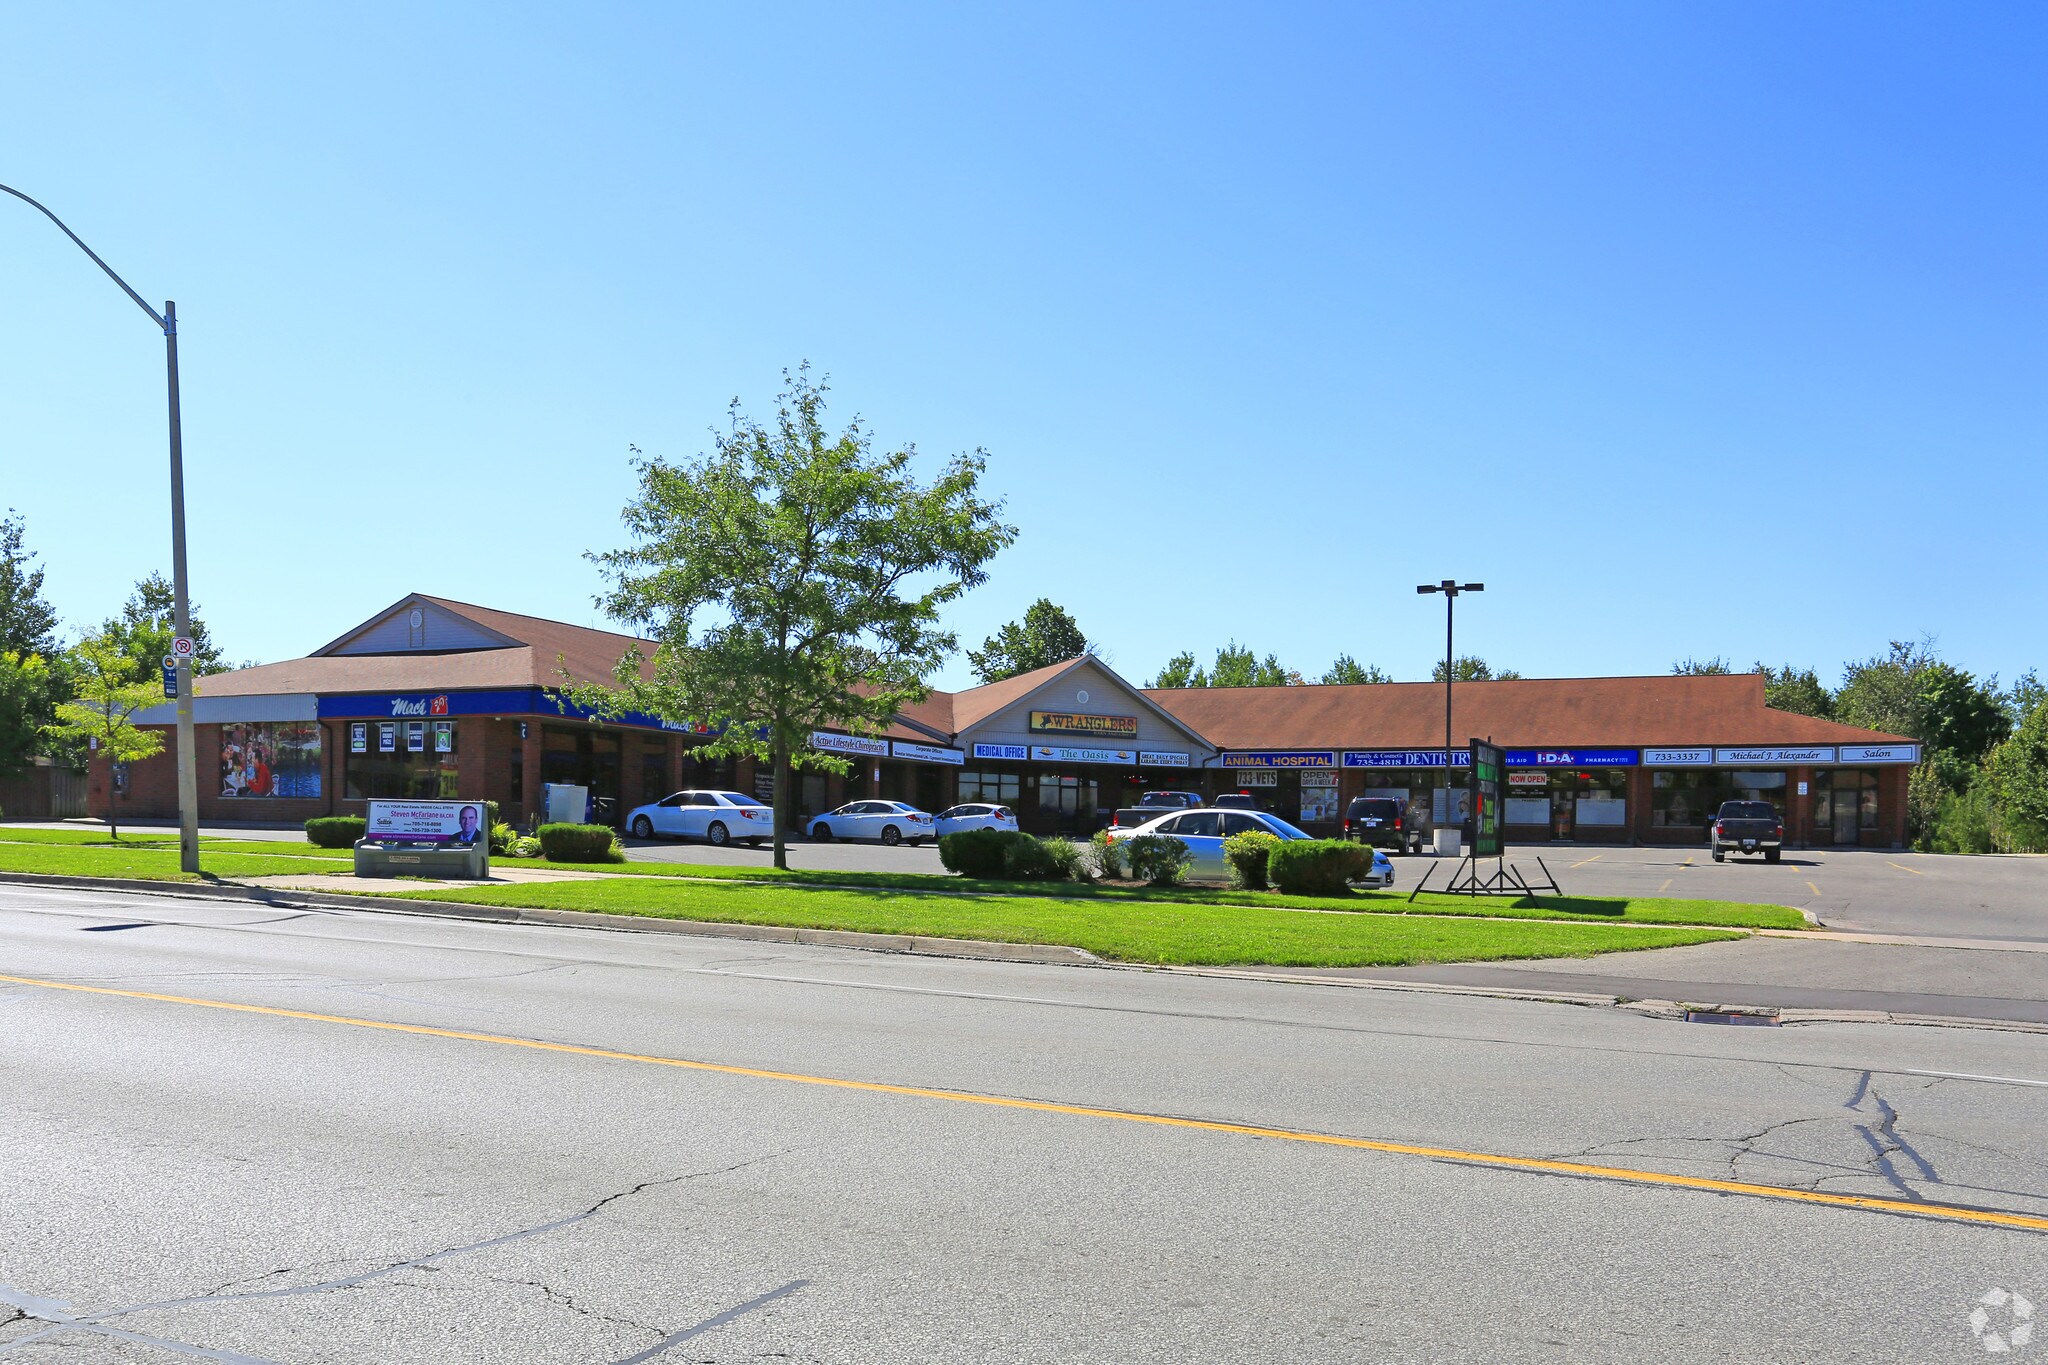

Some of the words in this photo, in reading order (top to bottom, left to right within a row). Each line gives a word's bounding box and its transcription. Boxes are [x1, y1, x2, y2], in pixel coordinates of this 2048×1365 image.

[391, 698, 427, 716] Mac's
[1052, 714, 1134, 732] WRANGLERS
[814, 735, 833, 746] Active
[833, 737, 855, 750] Lifestyle
[855, 740, 886, 752] Chiropractic
[915, 745, 932, 753] Corporate
[976, 745, 1003, 757] MEDICAL
[1004, 746, 1025, 758] OFFICE
[1059, 748, 1078, 758] The
[1082, 750, 1109, 760] Oasis
[1655, 752, 1700, 761] 733-3337
[1729, 750, 1766, 760] Michael
[1774, 750, 1820, 761] Alexander
[1862, 749, 1891, 759] Salon
[1224, 757, 1269, 766] ANIMAL
[1272, 756, 1331, 766] HOSPITAL
[1237, 771, 1276, 785] 733-VETS
[1302, 771, 1330, 779] OPEN
[1329, 771, 1339, 786] 7
[1510, 775, 1526, 783] NOW
[1527, 775, 1546, 783] OPEN
[390, 810, 410, 818] Steven
[410, 810, 439, 819] McFarlane
